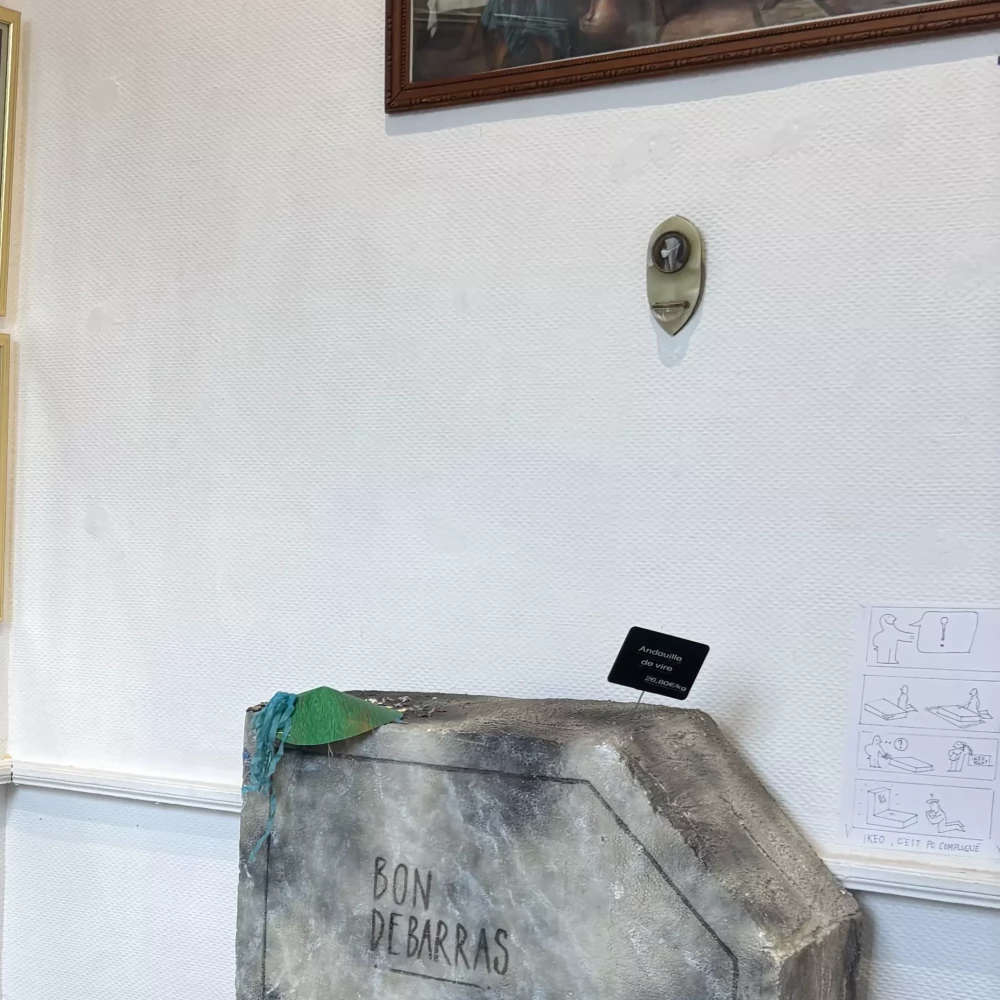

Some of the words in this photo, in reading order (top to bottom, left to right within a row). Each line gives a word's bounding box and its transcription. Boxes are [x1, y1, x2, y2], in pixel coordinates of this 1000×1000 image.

[863, 834, 885, 844] IKEO
[373, 856, 433, 911] BON
[370, 908, 509, 976] DEBARRAS
